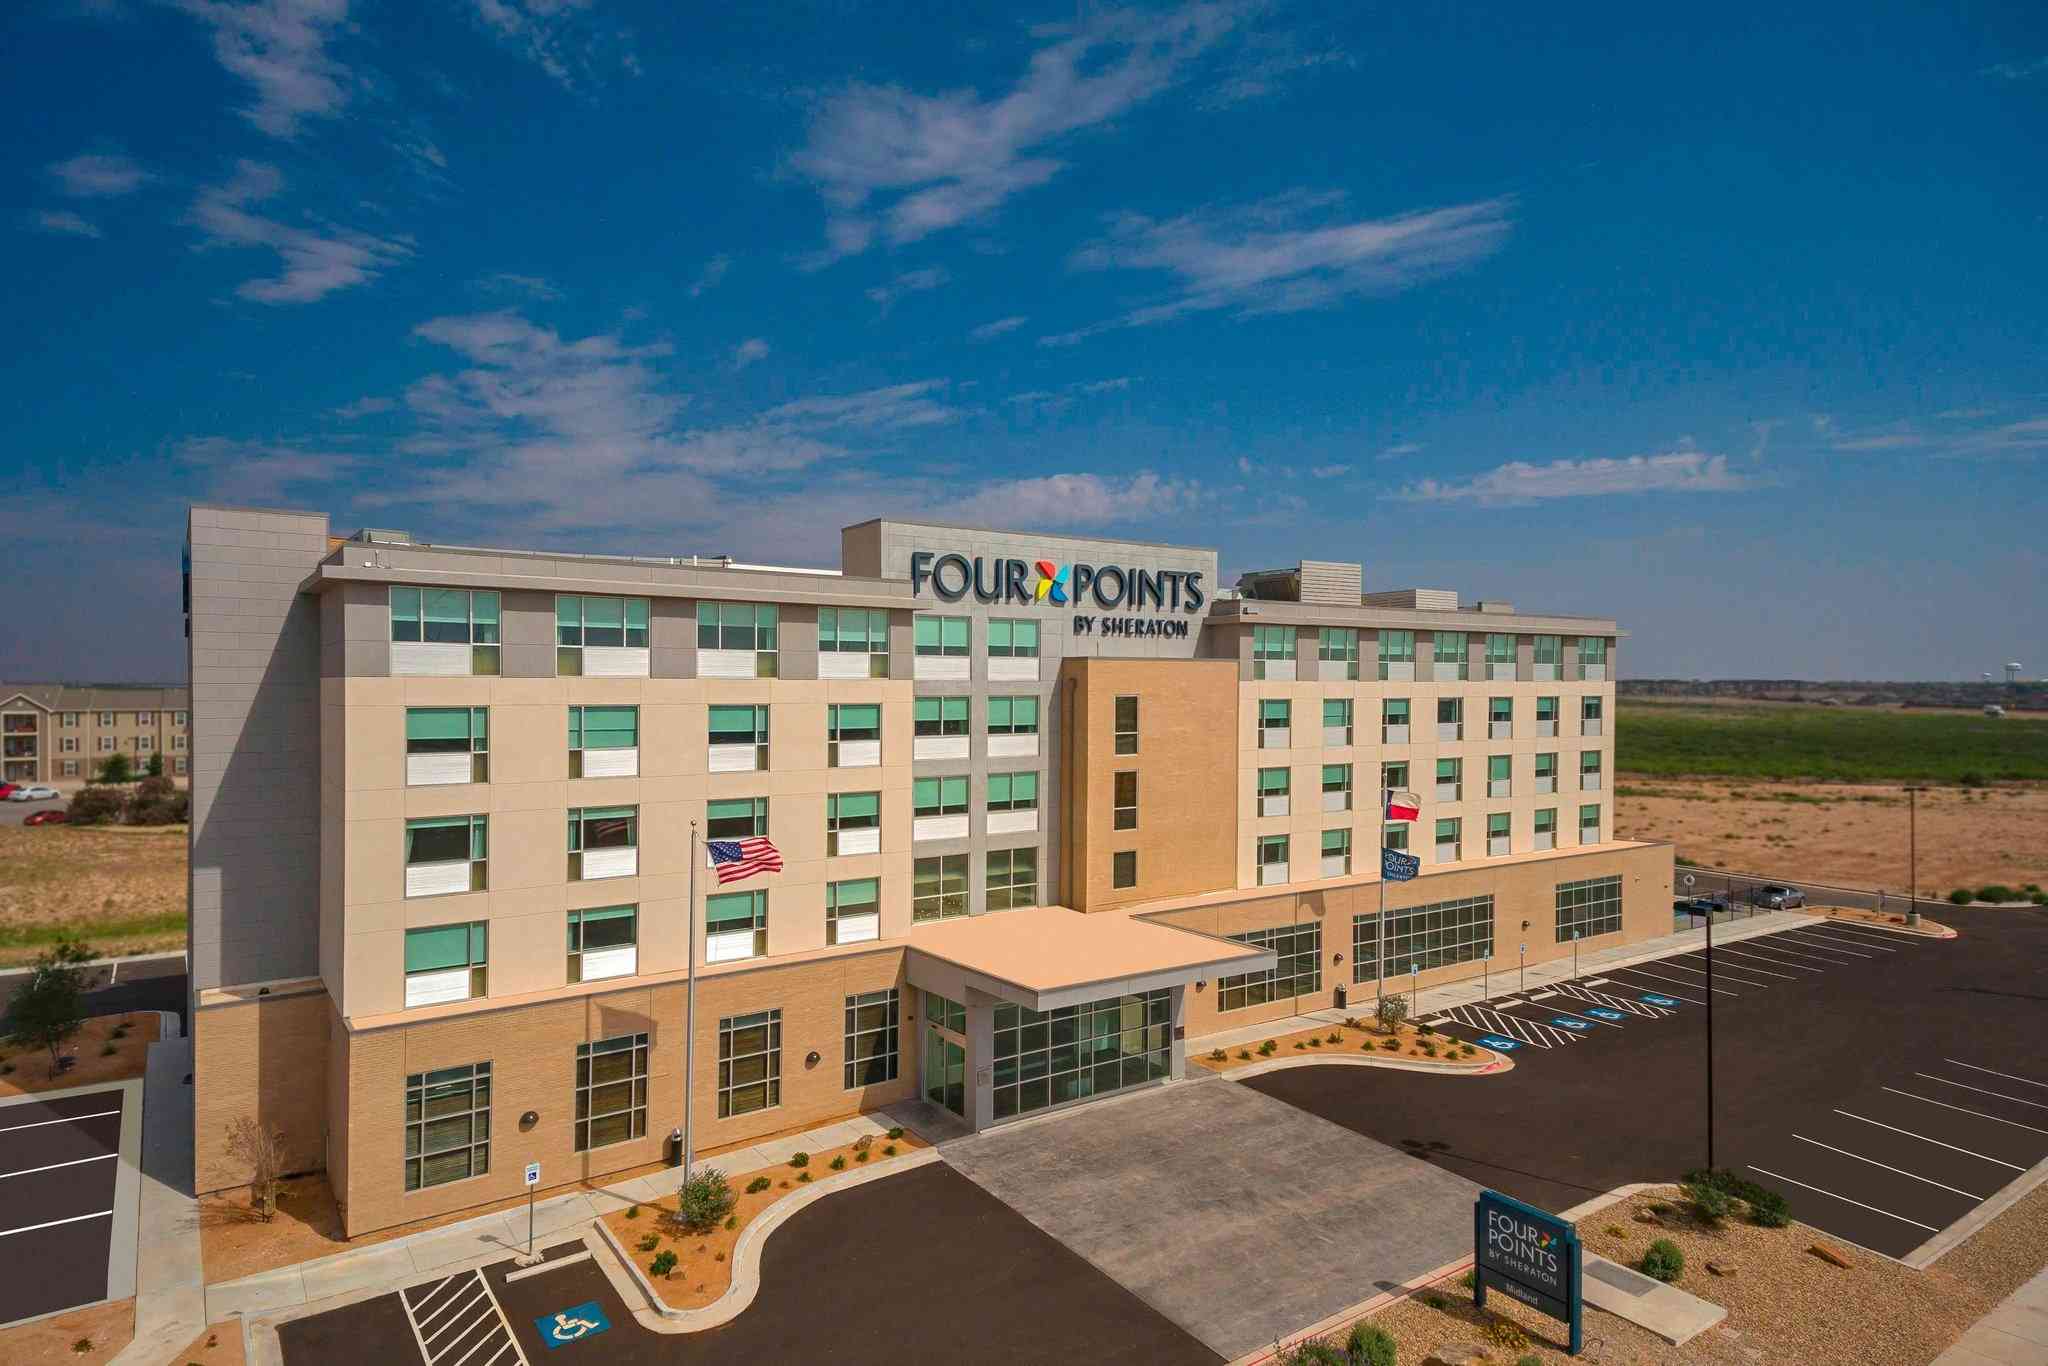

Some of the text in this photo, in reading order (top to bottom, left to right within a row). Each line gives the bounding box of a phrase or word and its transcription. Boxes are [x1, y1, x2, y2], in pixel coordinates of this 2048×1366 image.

[911, 551, 1204, 611] FOUR POINTS
[1073, 615, 1188, 638] BY SHERATON
[1385, 861, 1416, 875] OINTS
[1488, 1210, 1539, 1247] FOUR
[1488, 1228, 1557, 1272] POINTS
[1489, 1248, 1557, 1287] BY SHERATON
